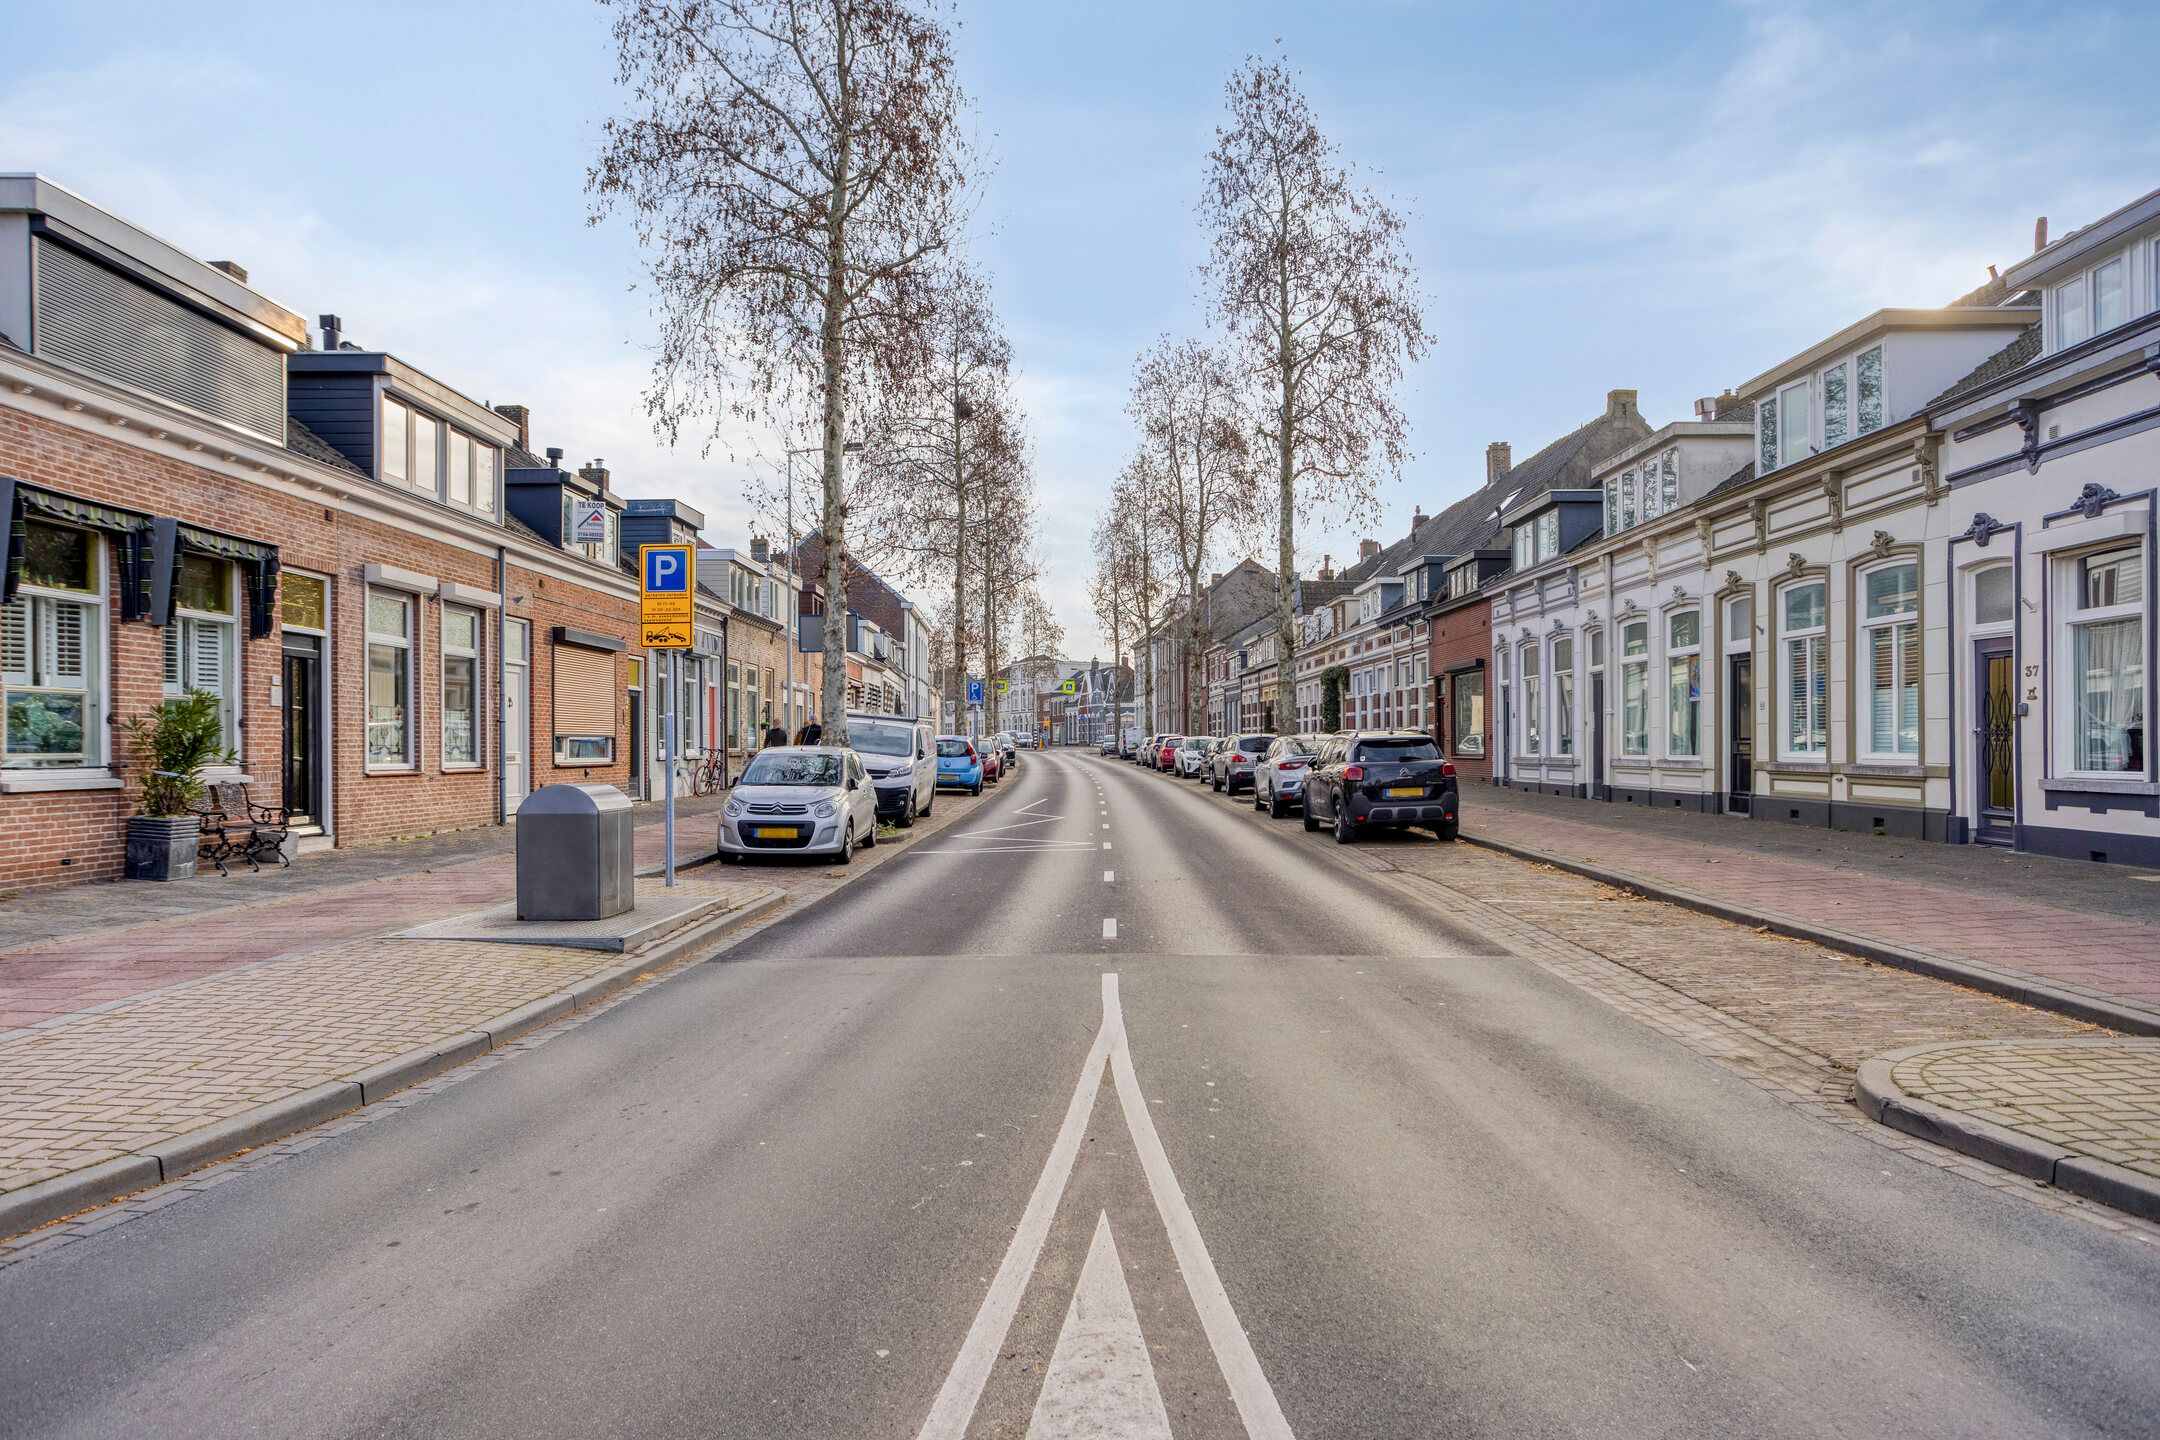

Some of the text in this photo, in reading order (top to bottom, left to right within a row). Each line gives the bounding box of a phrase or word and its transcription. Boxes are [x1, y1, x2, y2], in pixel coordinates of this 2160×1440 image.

[656, 556, 677, 586] P
[2025, 665, 2039, 677] 37
[972, 684, 979, 692] P
